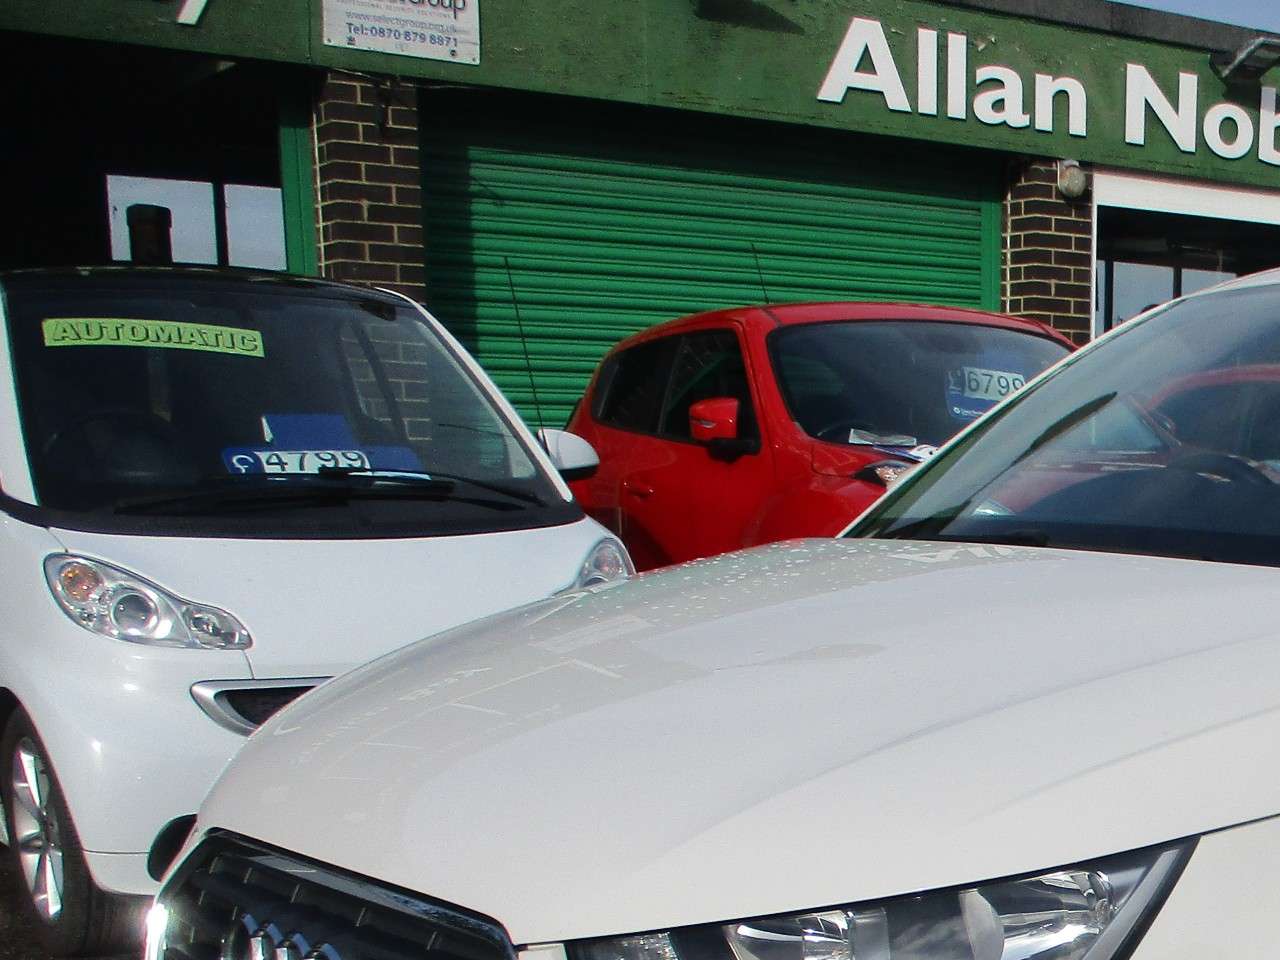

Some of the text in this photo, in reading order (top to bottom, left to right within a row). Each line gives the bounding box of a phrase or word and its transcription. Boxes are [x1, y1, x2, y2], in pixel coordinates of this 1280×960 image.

[405, 31, 426, 44] 879
[816, 16, 1088, 138] Allan
[52, 320, 258, 352] AUTOMATIC
